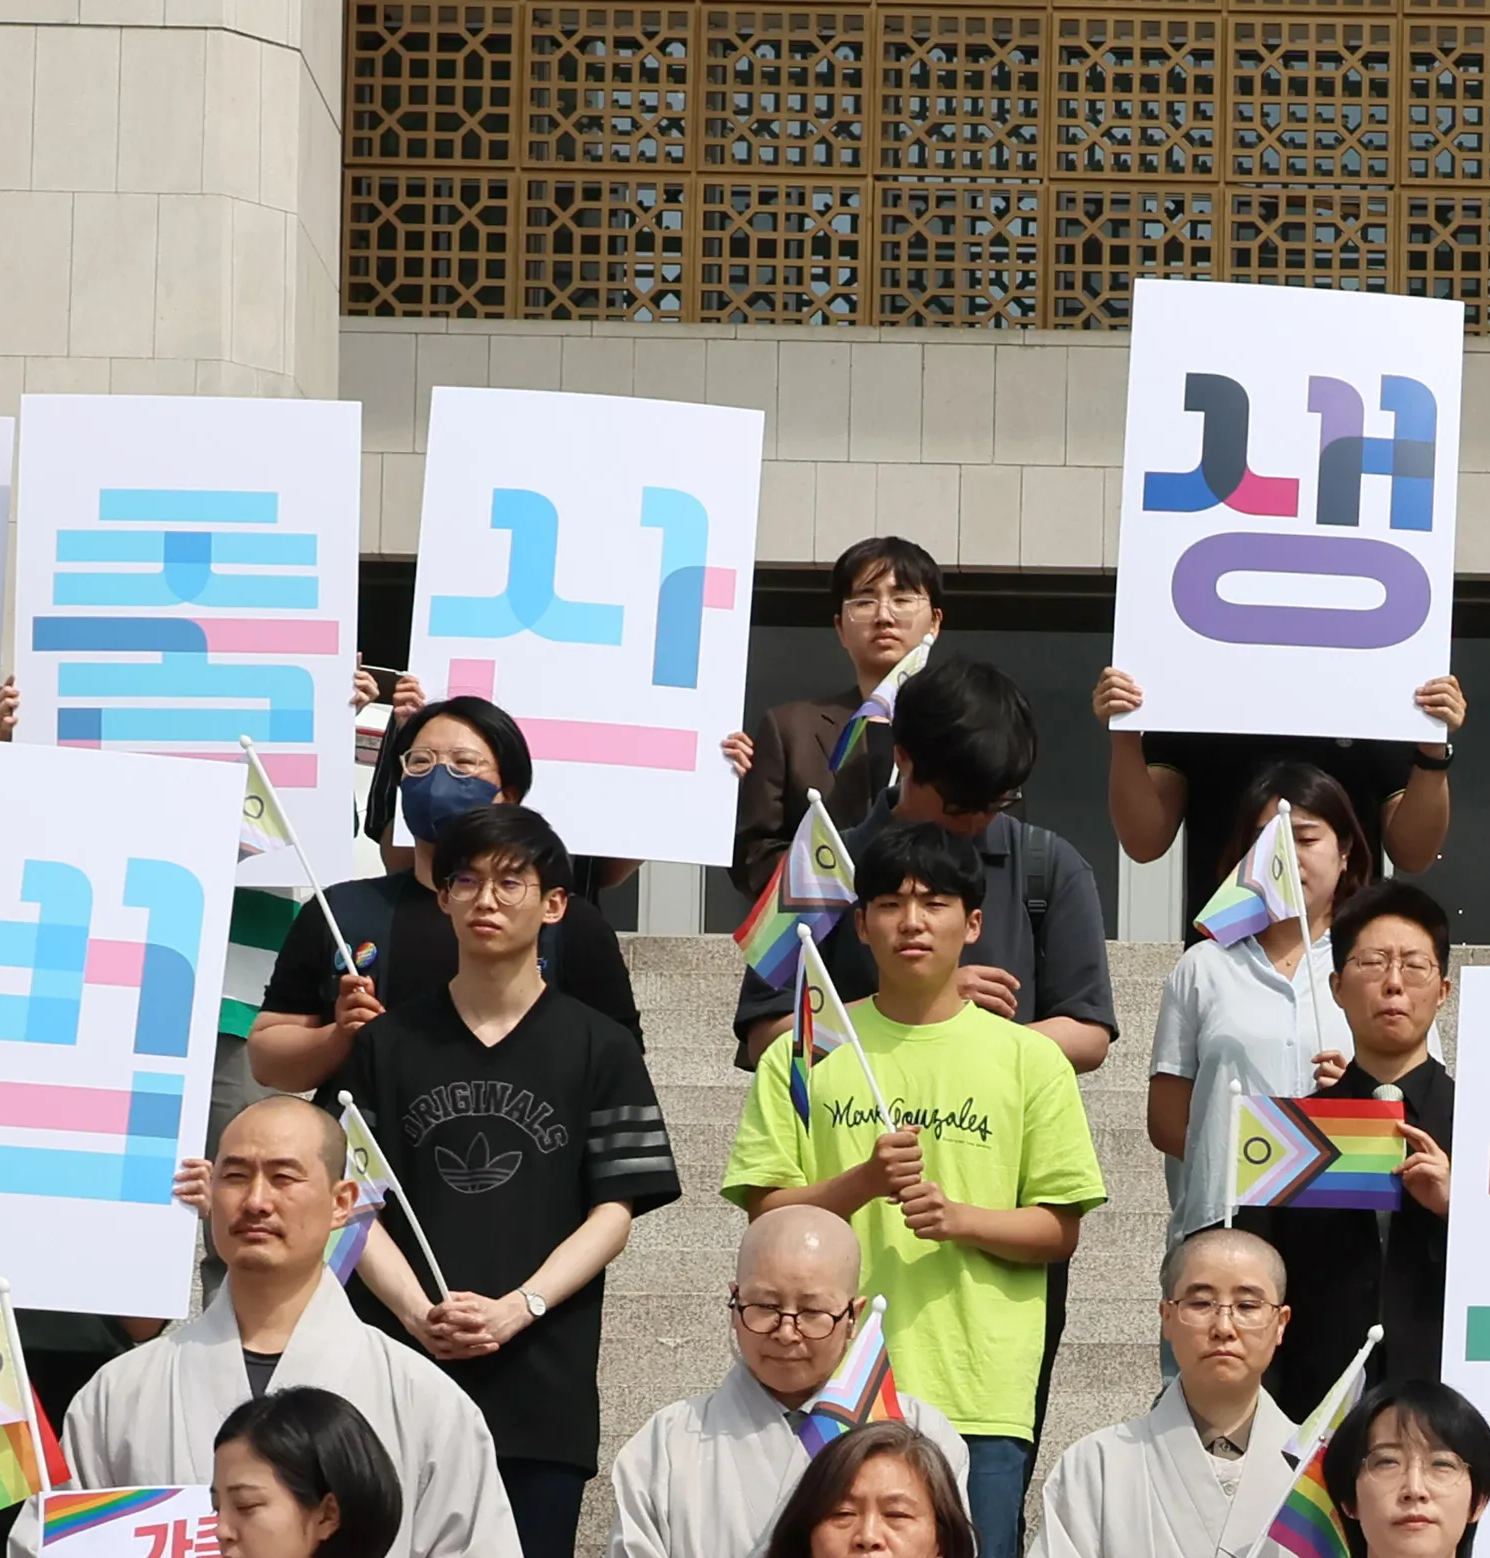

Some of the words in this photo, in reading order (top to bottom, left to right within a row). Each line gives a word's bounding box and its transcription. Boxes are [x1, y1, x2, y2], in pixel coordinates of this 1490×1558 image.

[32, 488, 339, 789] 출
[428, 488, 736, 771] 산
[1143, 371, 1437, 649] 생
[403, 1081, 569, 1154] ORIGINALS
